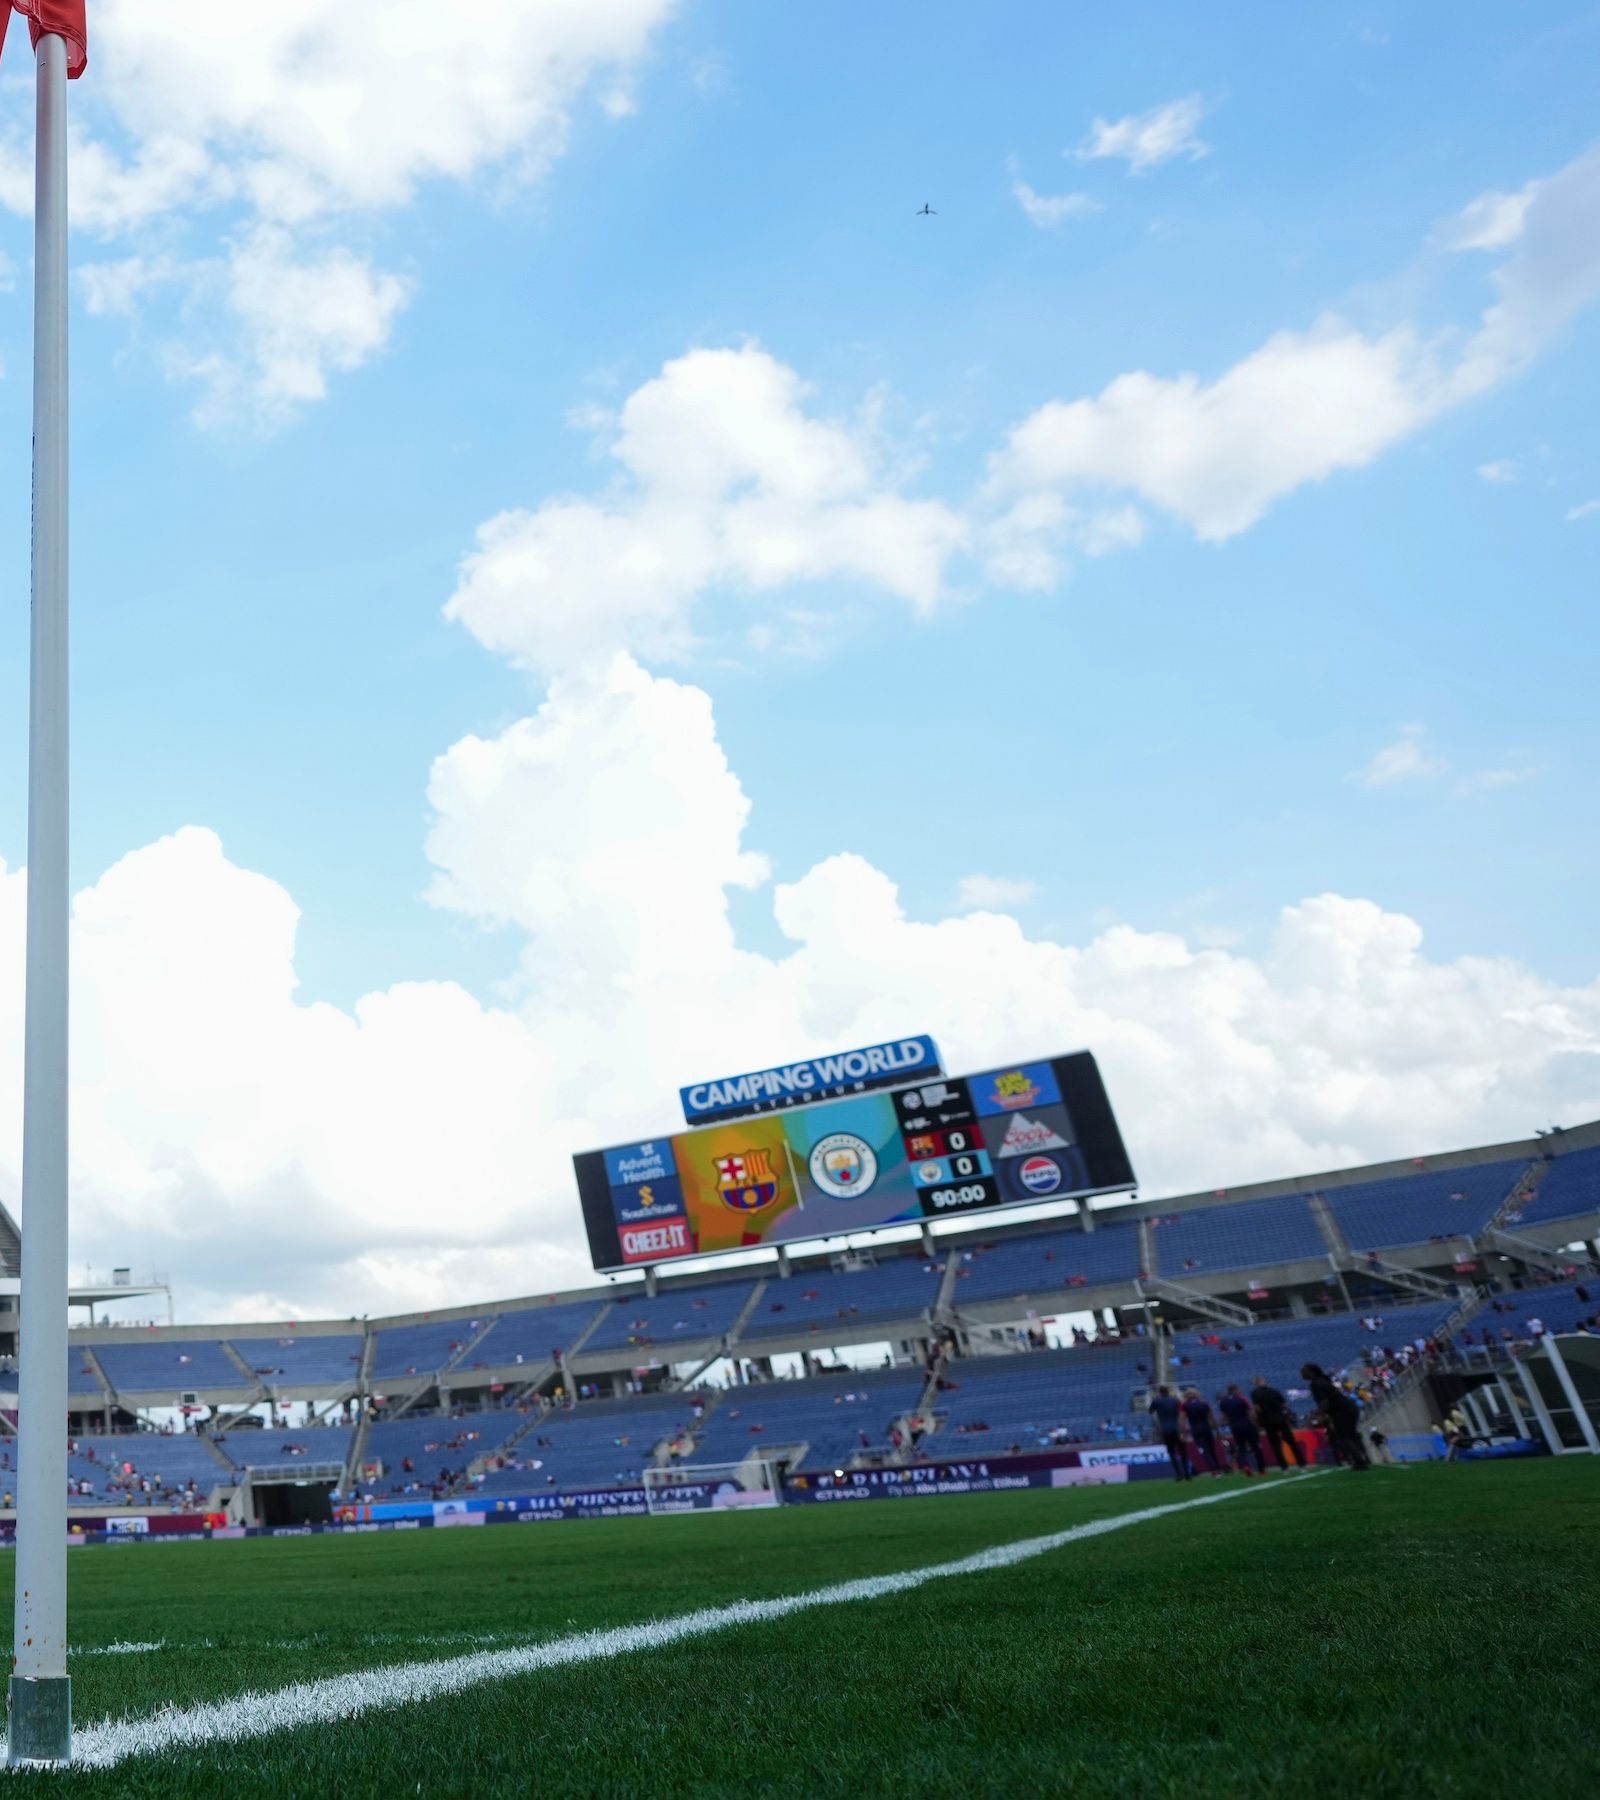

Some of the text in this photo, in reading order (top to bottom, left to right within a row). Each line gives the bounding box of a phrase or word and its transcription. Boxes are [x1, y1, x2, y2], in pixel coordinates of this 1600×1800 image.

[689, 1040, 925, 1110] CAMPING WORLD
[753, 1081, 866, 1113] STADIUM
[949, 1132, 966, 1150] 0
[618, 1153, 663, 1173] Advent
[956, 1157, 973, 1175] 0
[623, 1166, 666, 1184] Health
[931, 1184, 986, 1208] 90:00
[815, 1487, 871, 1500] ETIHAD
